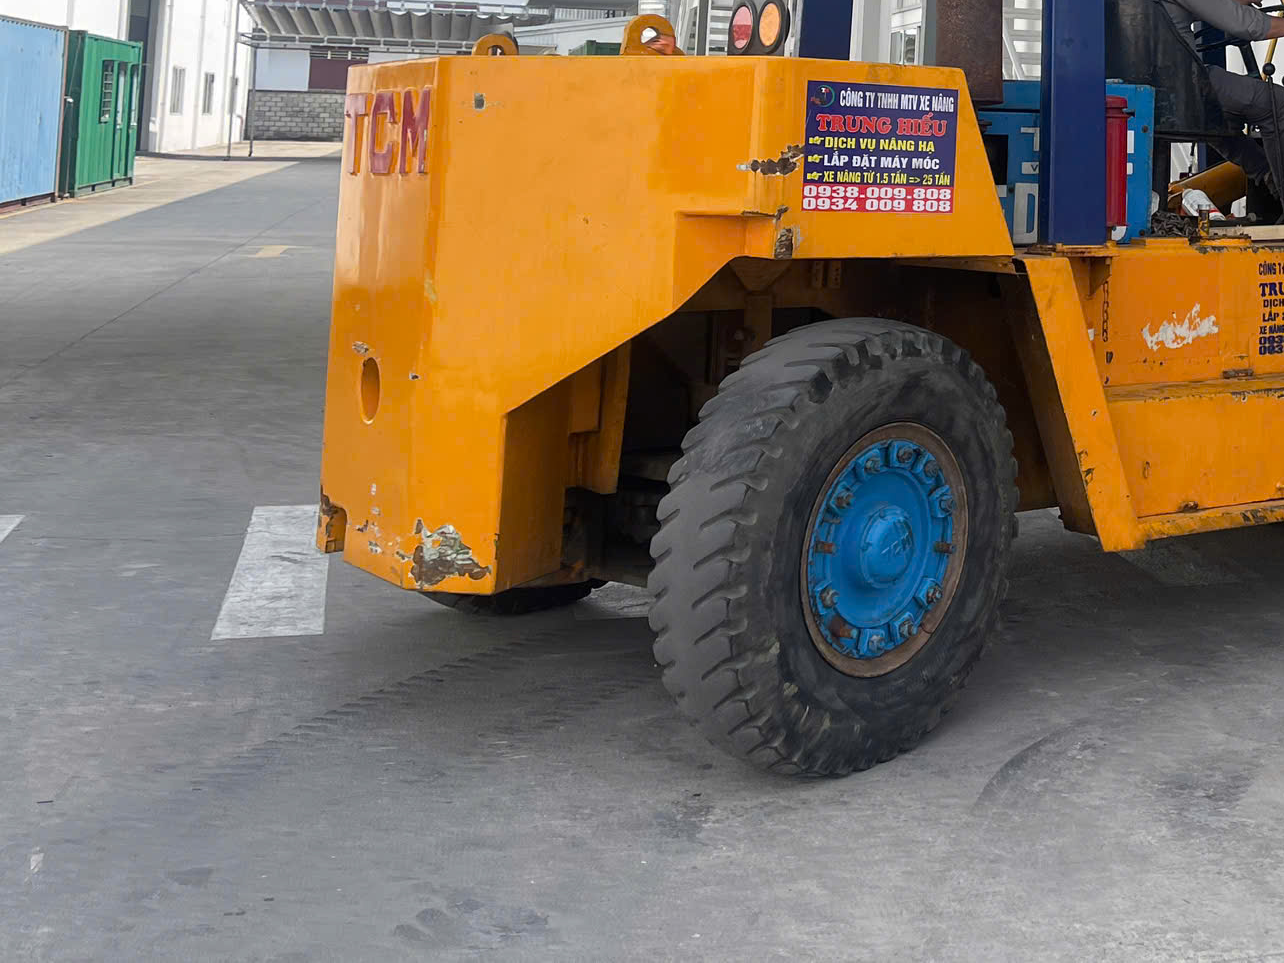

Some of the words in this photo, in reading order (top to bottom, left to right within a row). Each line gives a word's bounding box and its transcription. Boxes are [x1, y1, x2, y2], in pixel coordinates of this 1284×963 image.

[840, 87, 864, 108] CÔNG
[866, 92, 875, 108] TY
[877, 93, 899, 109] TNHH
[901, 94, 919, 110] MTV
[920, 95, 930, 111] XE
[932, 93, 954, 112] NÂNG
[345, 90, 431, 175] TCM
[816, 114, 892, 134] TRUNG
[897, 112, 947, 137] HIẾU
[825, 137, 856, 151] DỊCH
[860, 138, 876, 152] VỤ
[880, 138, 915, 152] NÂNG
[918, 141, 935, 154] HẠ
[824, 151, 848, 167] LẮP
[852, 154, 877, 169] ĐẶT
[880, 155, 908, 169] MÁY
[911, 155, 940, 170] MÓC
[823, 171, 834, 182] XE
[837, 169, 860, 183] NÂNG
[876, 173, 888, 184] 1.5
[922, 175, 932, 185] 25
[803, 185, 951, 200] 0938.009.808
[802, 197, 858, 210] 0934
[866, 198, 906, 211] 009
[912, 200, 951, 212] 808
[1263, 297, 1284, 311] DỊCH
